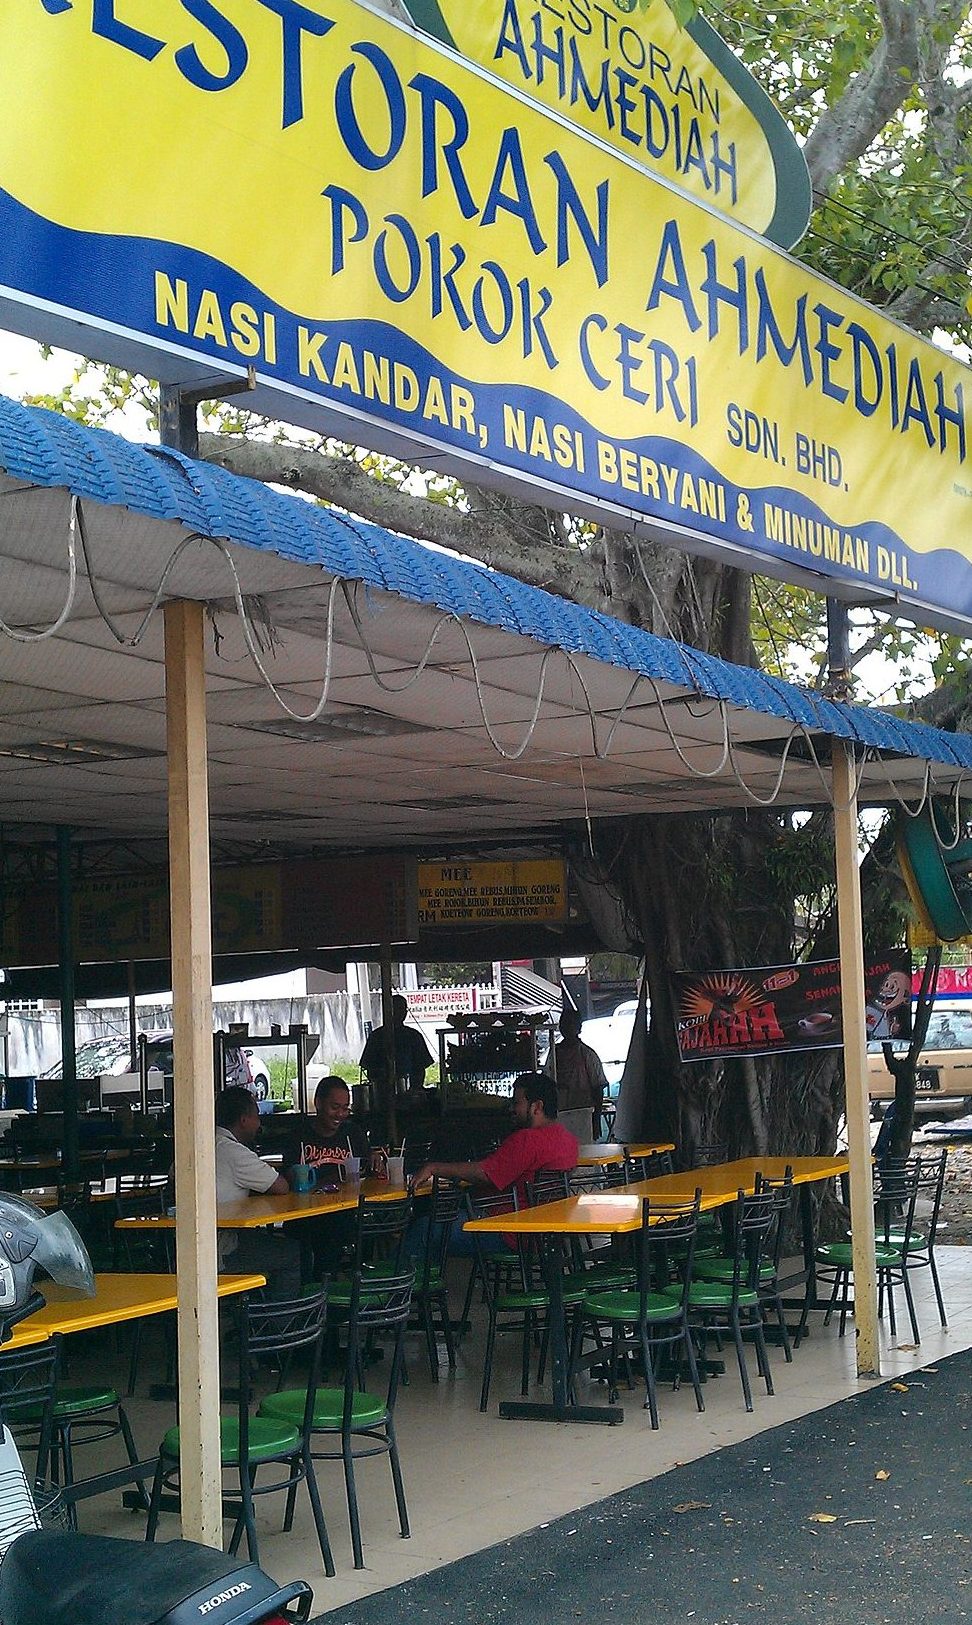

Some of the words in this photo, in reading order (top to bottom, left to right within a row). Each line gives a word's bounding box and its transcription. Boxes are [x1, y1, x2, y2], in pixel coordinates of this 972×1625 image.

[493, 0, 738, 206] AHMEDIAH
[534, 0, 720, 123] STORAN
[41, 0, 609, 288] STORAN
[646, 219, 967, 464] AHMEDIAH
[154, 270, 276, 365] NASI
[298, 325, 488, 448] KANDAR,
[503, 403, 585, 473] NASI
[597, 439, 726, 523] BERYANI
[736, 492, 754, 533] &
[764, 502, 869, 570] MINUMAN
[876, 545, 918, 591] DLL.
[320, 184, 559, 370] POKOK
[579, 313, 698, 428] CERI
[726, 402, 787, 467] SDN.
[796, 433, 849, 492] BHD.
[441, 867, 472, 881] MEE
[198, 1582, 252, 1615] HONDA
